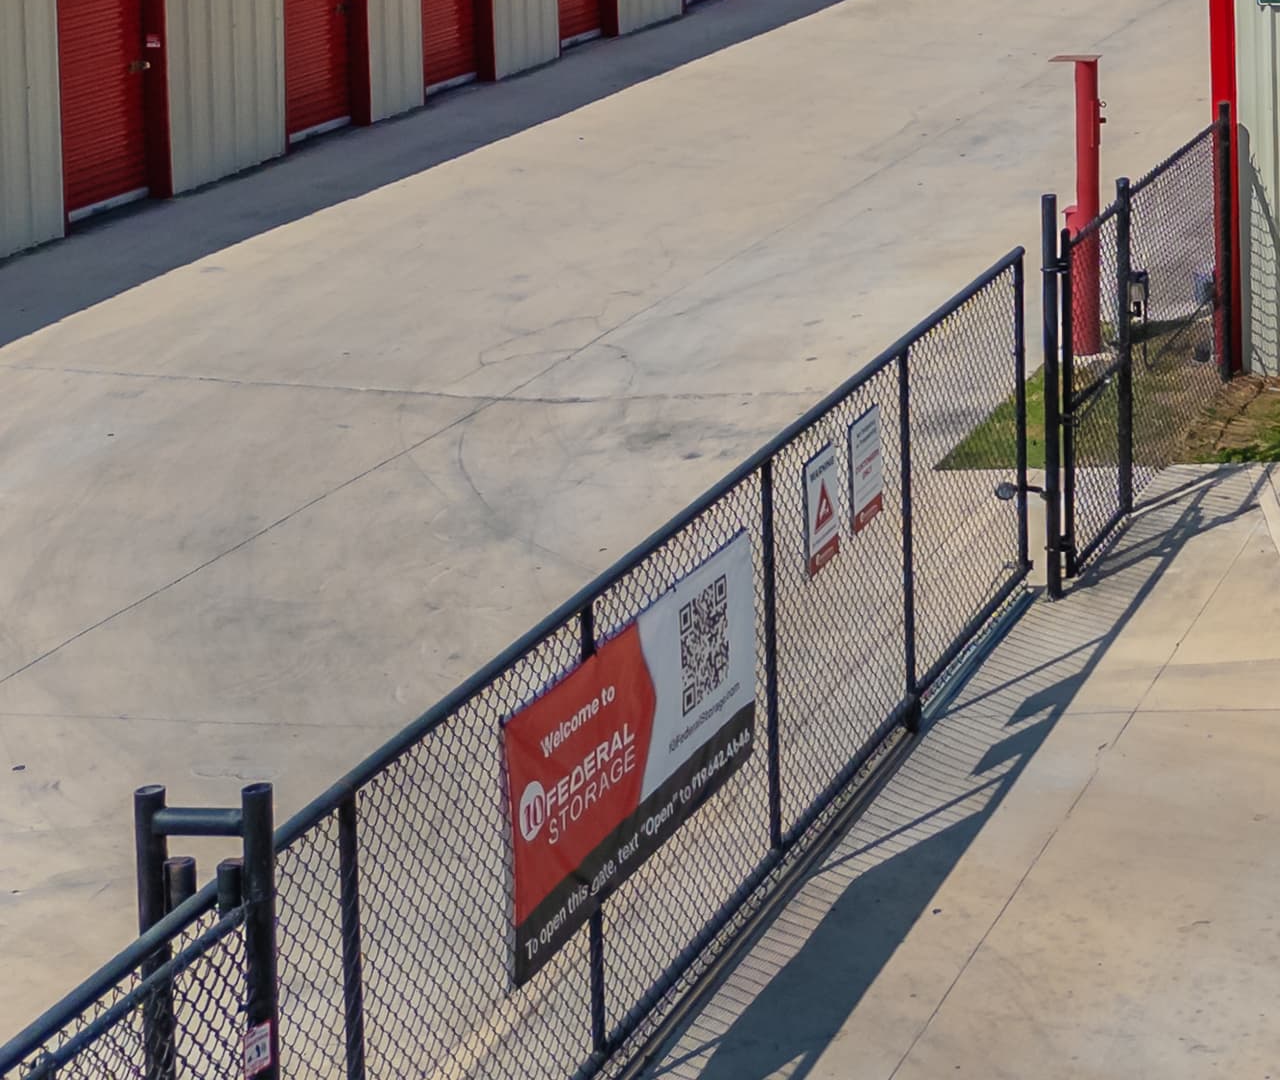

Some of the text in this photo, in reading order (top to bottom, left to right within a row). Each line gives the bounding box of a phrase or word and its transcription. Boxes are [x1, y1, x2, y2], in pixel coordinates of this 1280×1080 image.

[541, 686, 615, 758] Welcome to
[546, 723, 635, 816] FEDERAL
[548, 745, 635, 844] STORAGE
[525, 937, 538, 960] To
[540, 907, 566, 942] open
[568, 883, 589, 914] this
[590, 860, 617, 896] gate,
[618, 833, 639, 864] text
[679, 787, 692, 804] to
